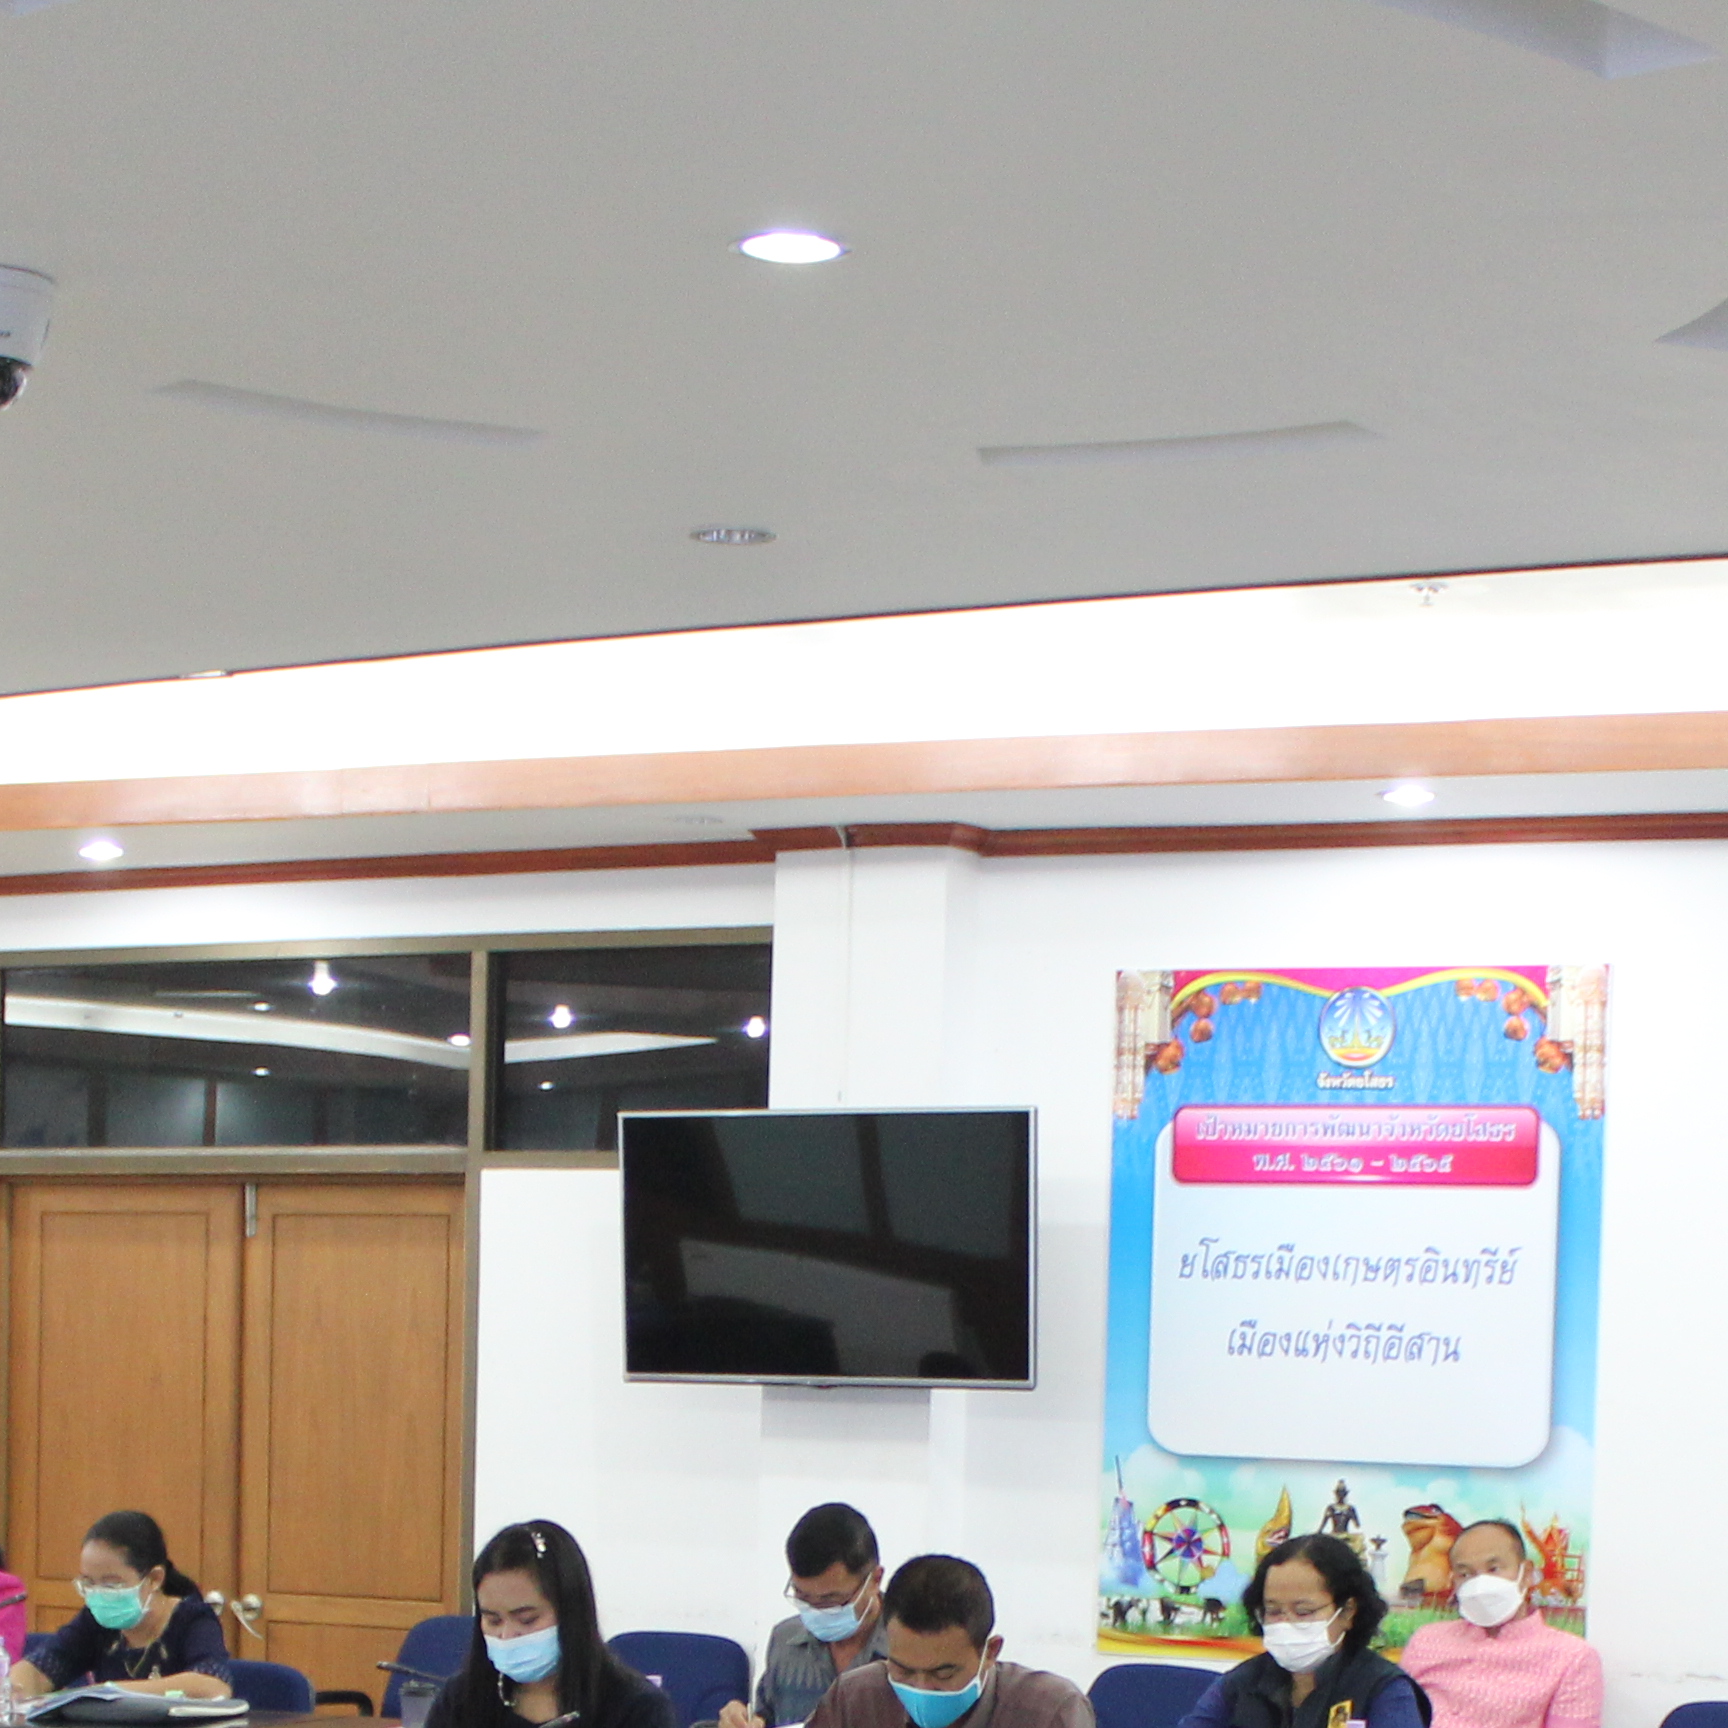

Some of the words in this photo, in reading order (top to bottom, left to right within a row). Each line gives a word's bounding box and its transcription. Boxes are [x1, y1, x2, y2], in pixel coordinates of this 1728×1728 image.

[1178, 1237, 1523, 1289] ยโสธรเมืองเกษตรอินทรีย์
[1226, 1319, 1463, 1366] เมืองแห่งวิถีอีสาน
